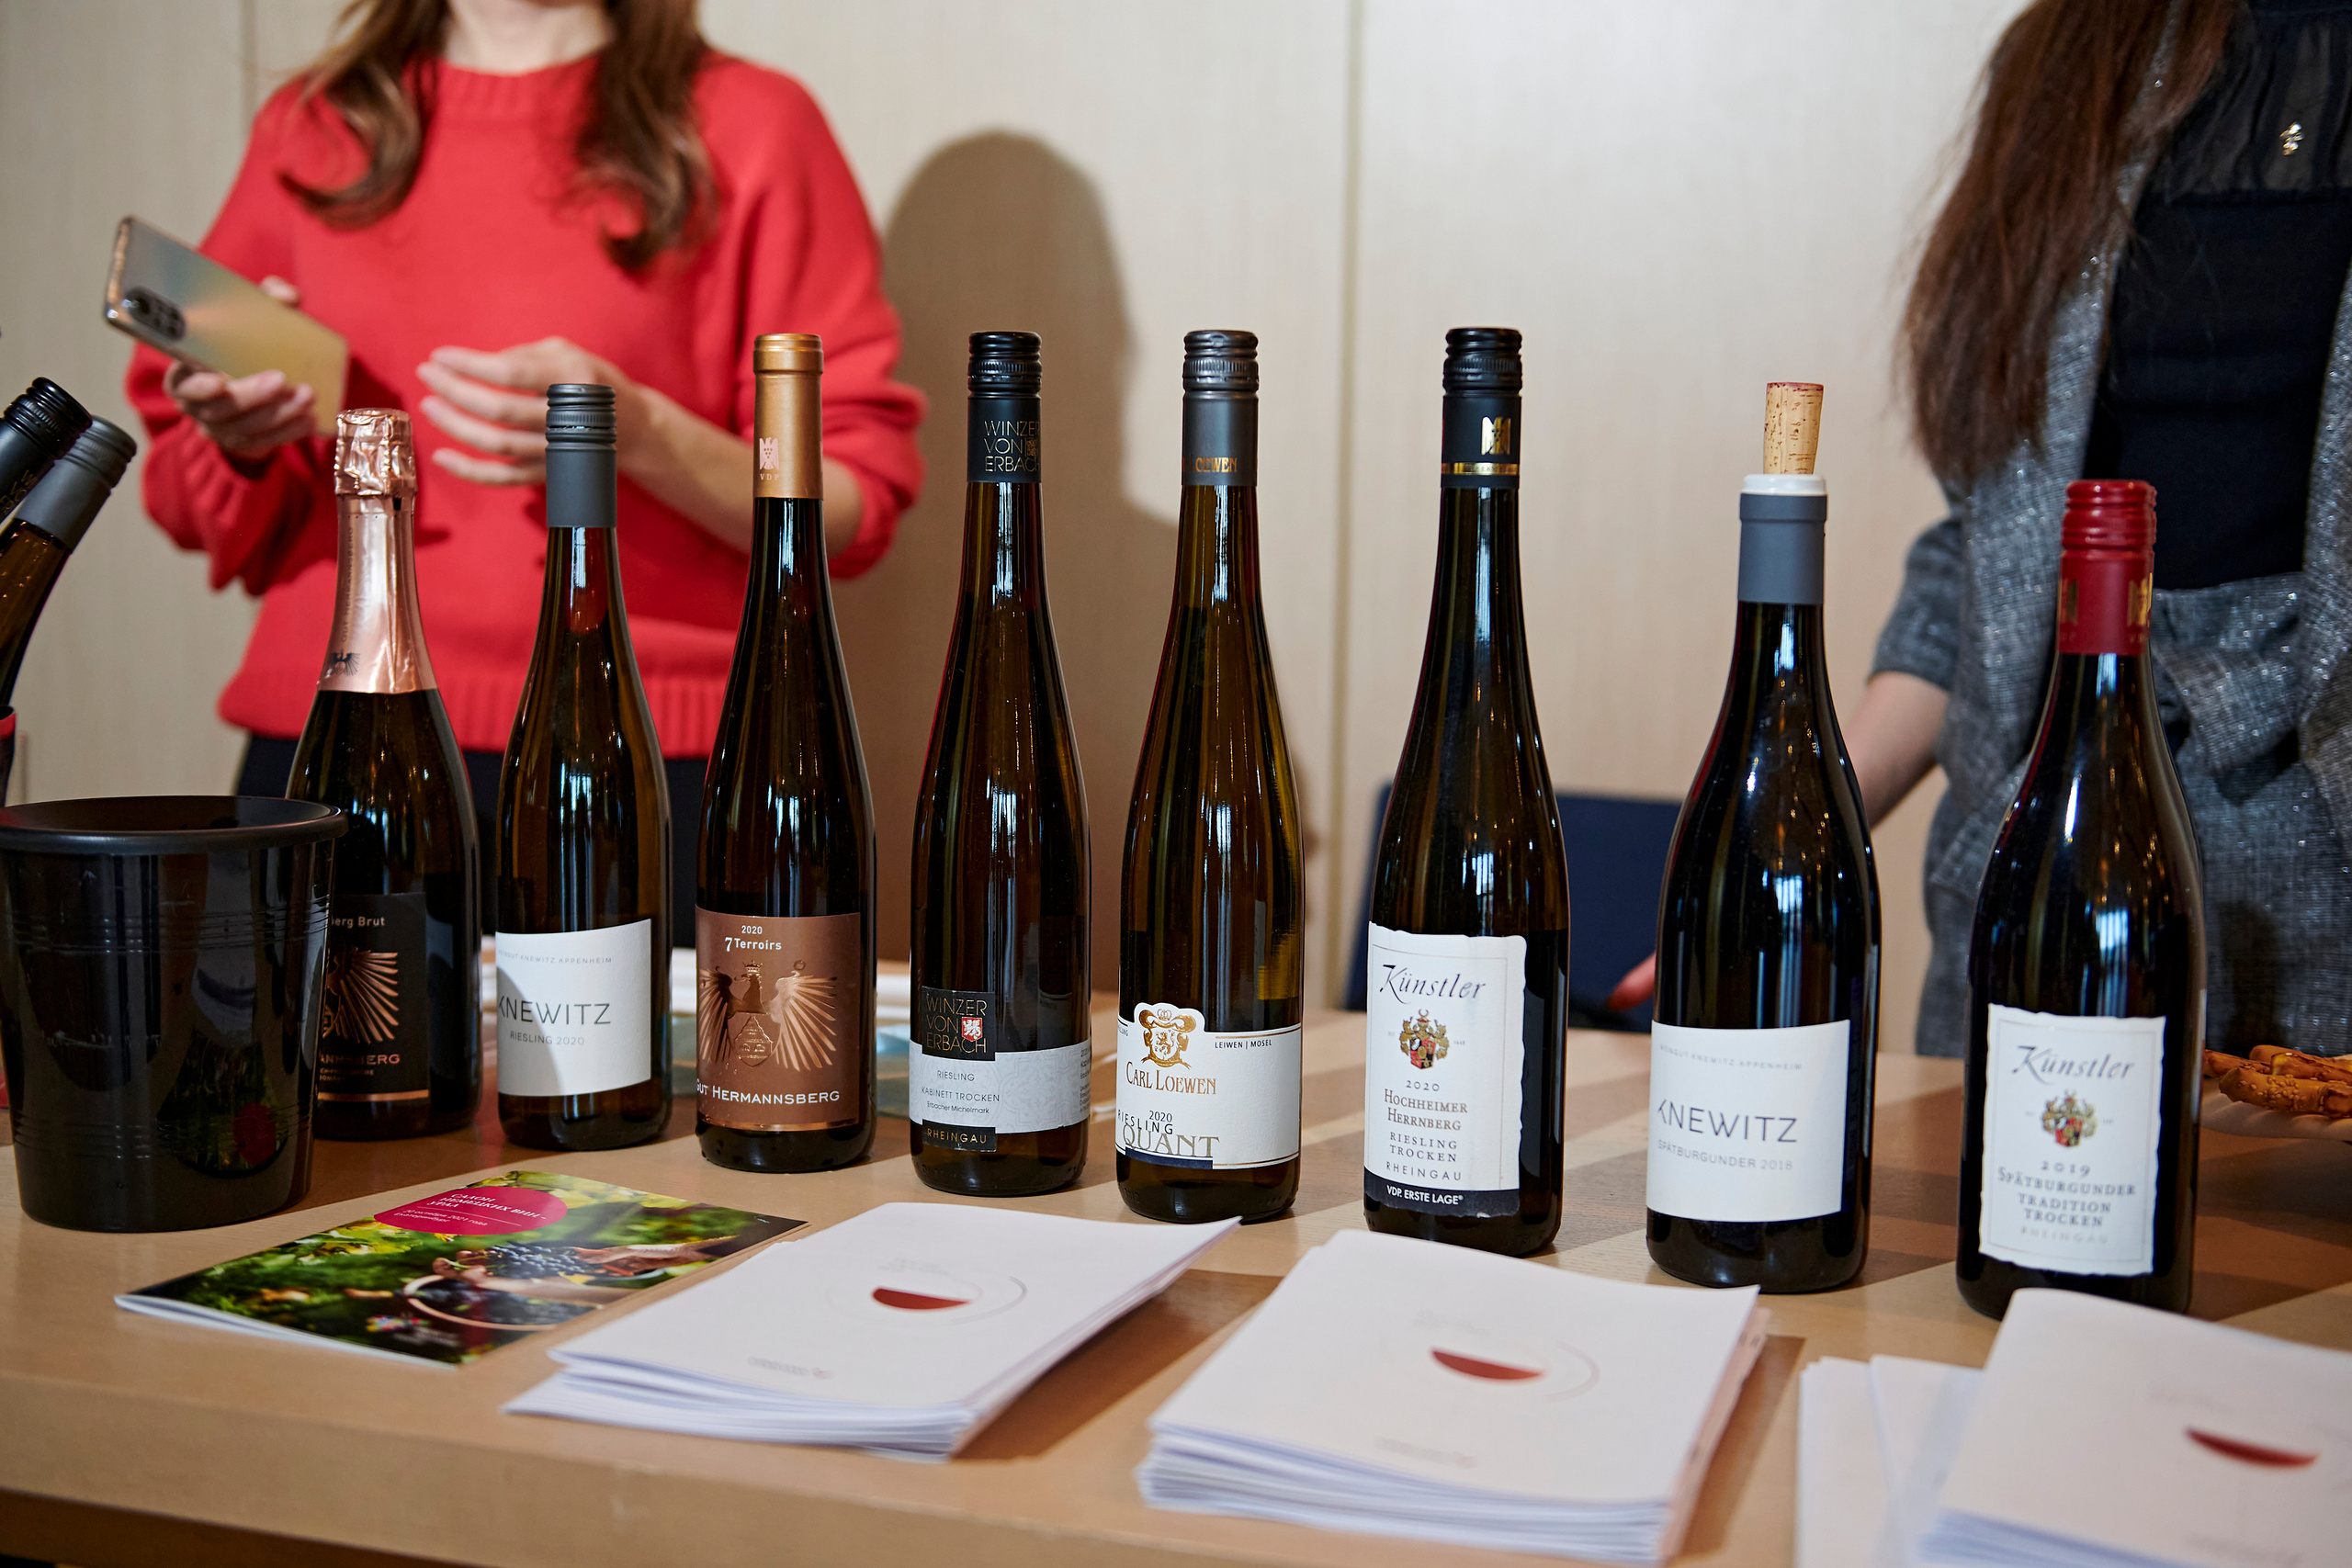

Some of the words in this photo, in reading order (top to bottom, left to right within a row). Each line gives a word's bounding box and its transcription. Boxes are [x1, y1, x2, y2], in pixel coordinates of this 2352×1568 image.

[984, 437, 1023, 455] VON
[357, 916, 385, 927] Brut
[741, 925, 763, 935] 2020
[724, 937, 733, 953] 7
[734, 938, 782, 951] Terroirs
[520, 955, 555, 964] KNEWITZ
[1379, 964, 1487, 1005] Künstler
[499, 995, 611, 1025] KNEWITZ
[926, 996, 988, 1017] WINZER
[926, 1015, 959, 1034] VON
[510, 1031, 553, 1045] RIESLING
[557, 1035, 585, 1046] 2020
[926, 1032, 987, 1054] ERBACH
[1250, 1039, 1272, 1048] MOSEL
[2011, 1044, 2135, 1085] Künstler
[936, 1069, 975, 1082] RIESLING
[1125, 1061, 1153, 1089] CARL
[1156, 1069, 1217, 1095] LOEWEN
[696, 1077, 708, 1096] GUT
[712, 1085, 841, 1105] HERMANNSBERG
[921, 1086, 953, 1100] KABINETT
[956, 1091, 1001, 1102] TROCKEN
[1406, 1079, 1441, 1092] 2020
[927, 1100, 950, 1112] Erbacher
[951, 1103, 989, 1114] Michelmark
[1385, 1089, 1468, 1113] HOCHHEIMER
[1117, 1109, 1174, 1135] RIESLING
[1148, 1110, 1173, 1123] 2020
[1387, 1107, 1462, 1131] HERRNBERG
[1657, 1099, 1798, 1143] KNEWITZ
[927, 1127, 987, 1145] RHEINGAU
[1123, 1122, 1221, 1157] QUANT
[1390, 1132, 1457, 1150] RIESLING
[1389, 1144, 1457, 1163] TROCKEN
[1657, 1139, 1757, 1168] SPÄTBURGUNDER
[1759, 1159, 1793, 1171] 2018
[1385, 1161, 1462, 1181] RHEINGAU
[2041, 1160, 2091, 1178] 2019
[1997, 1166, 2136, 1196] SPÄTBURGUNDER
[1404, 1189, 1430, 1202] ERSTE
[2017, 1192, 2111, 1213] TRADITION
[2023, 1208, 2104, 1227] TROCKEN
